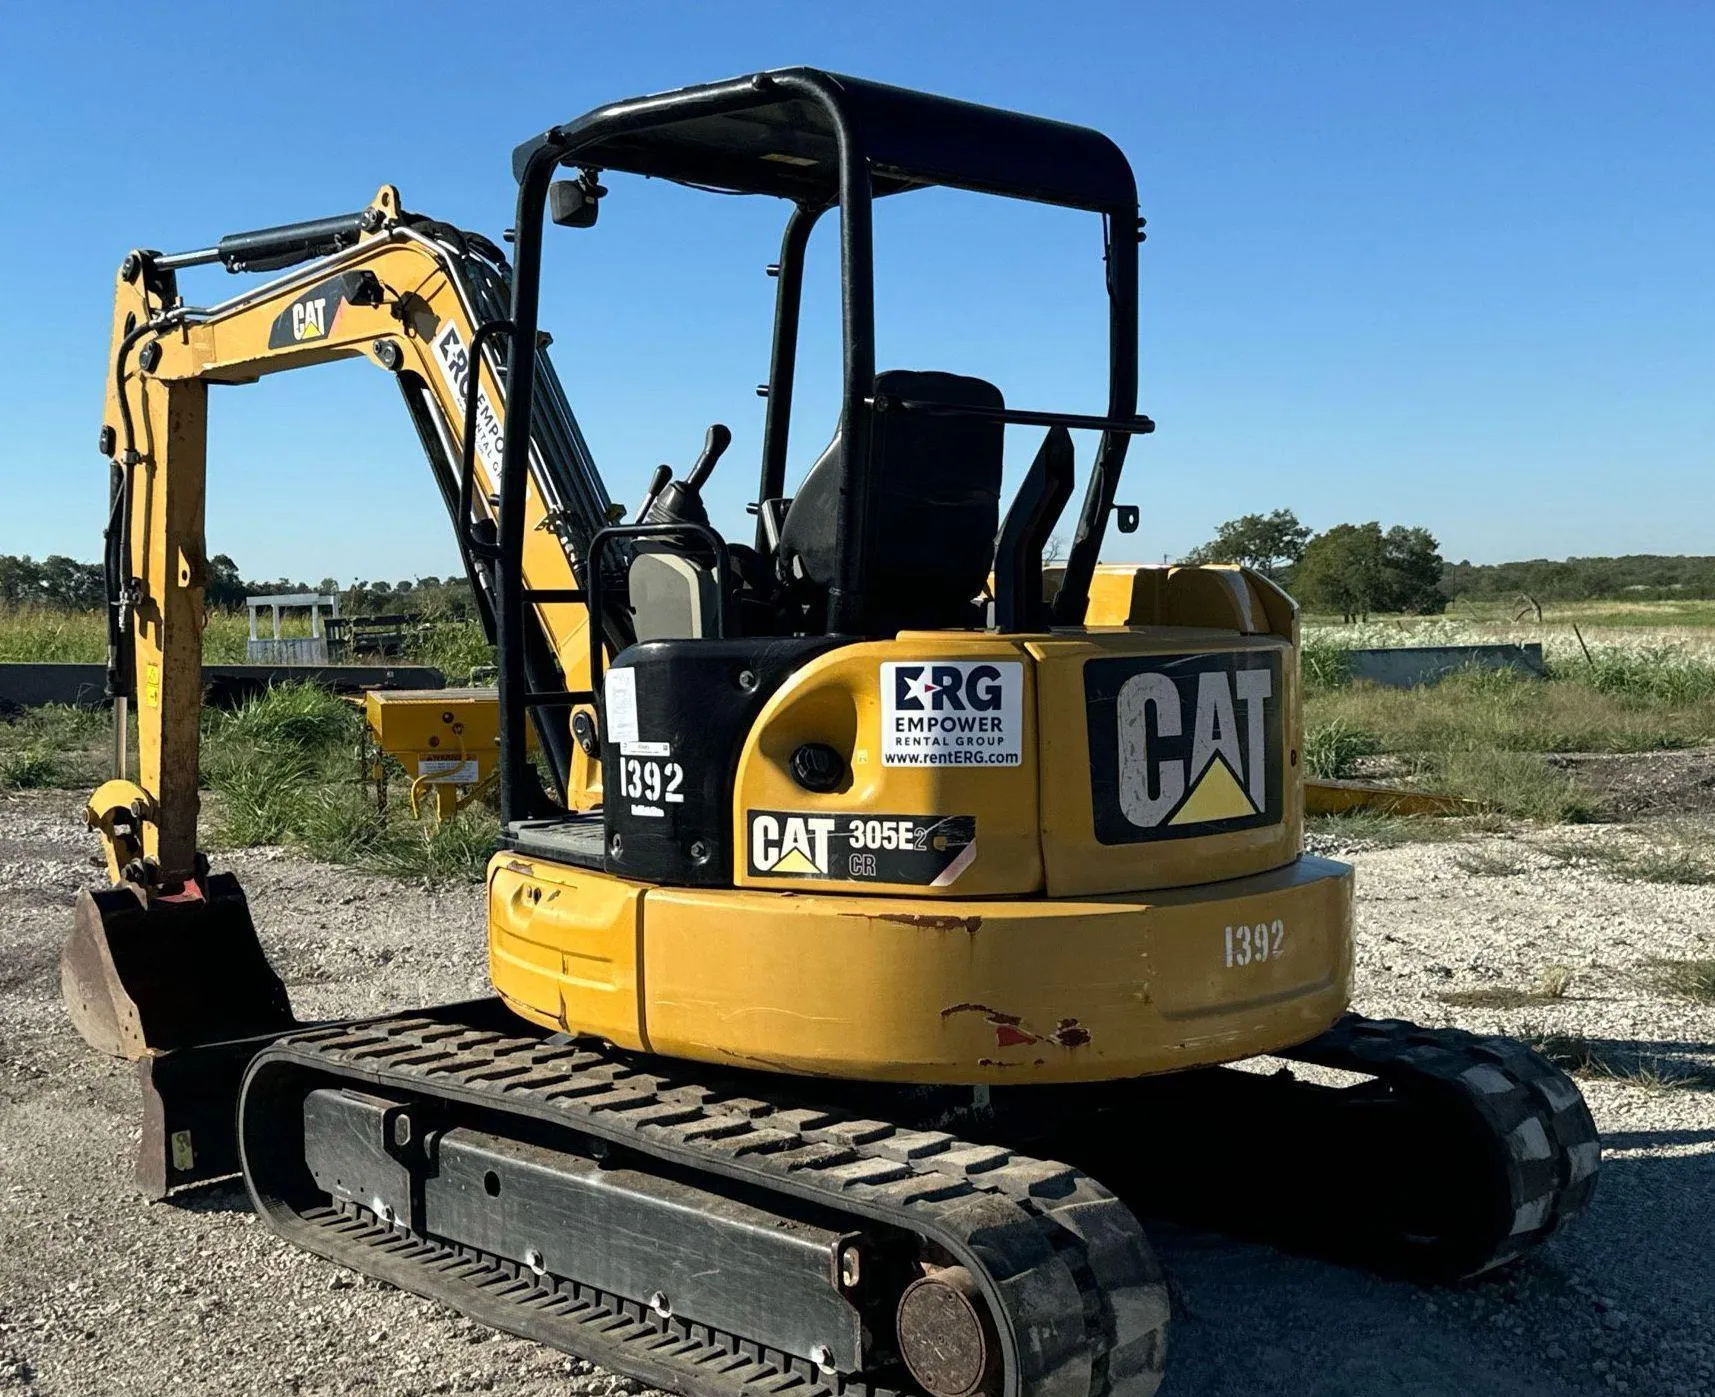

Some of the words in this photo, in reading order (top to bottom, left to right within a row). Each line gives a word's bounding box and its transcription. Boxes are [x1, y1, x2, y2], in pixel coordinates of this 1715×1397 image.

[292, 298, 326, 340] CAT
[477, 393, 504, 453] EMPO
[895, 665, 1002, 712] ERG
[896, 717, 1003, 733] EMPOWER
[896, 736, 949, 746] RENTAL
[955, 736, 1004, 746] GROUP
[885, 750, 1018, 764] www.rentERG.com
[1117, 668, 1272, 828] CAT
[619, 756, 684, 803] 1392
[752, 815, 835, 874] CAT
[849, 819, 928, 851] 305E2
[849, 853, 876, 876] CR
[1224, 919, 1284, 968] 1392
